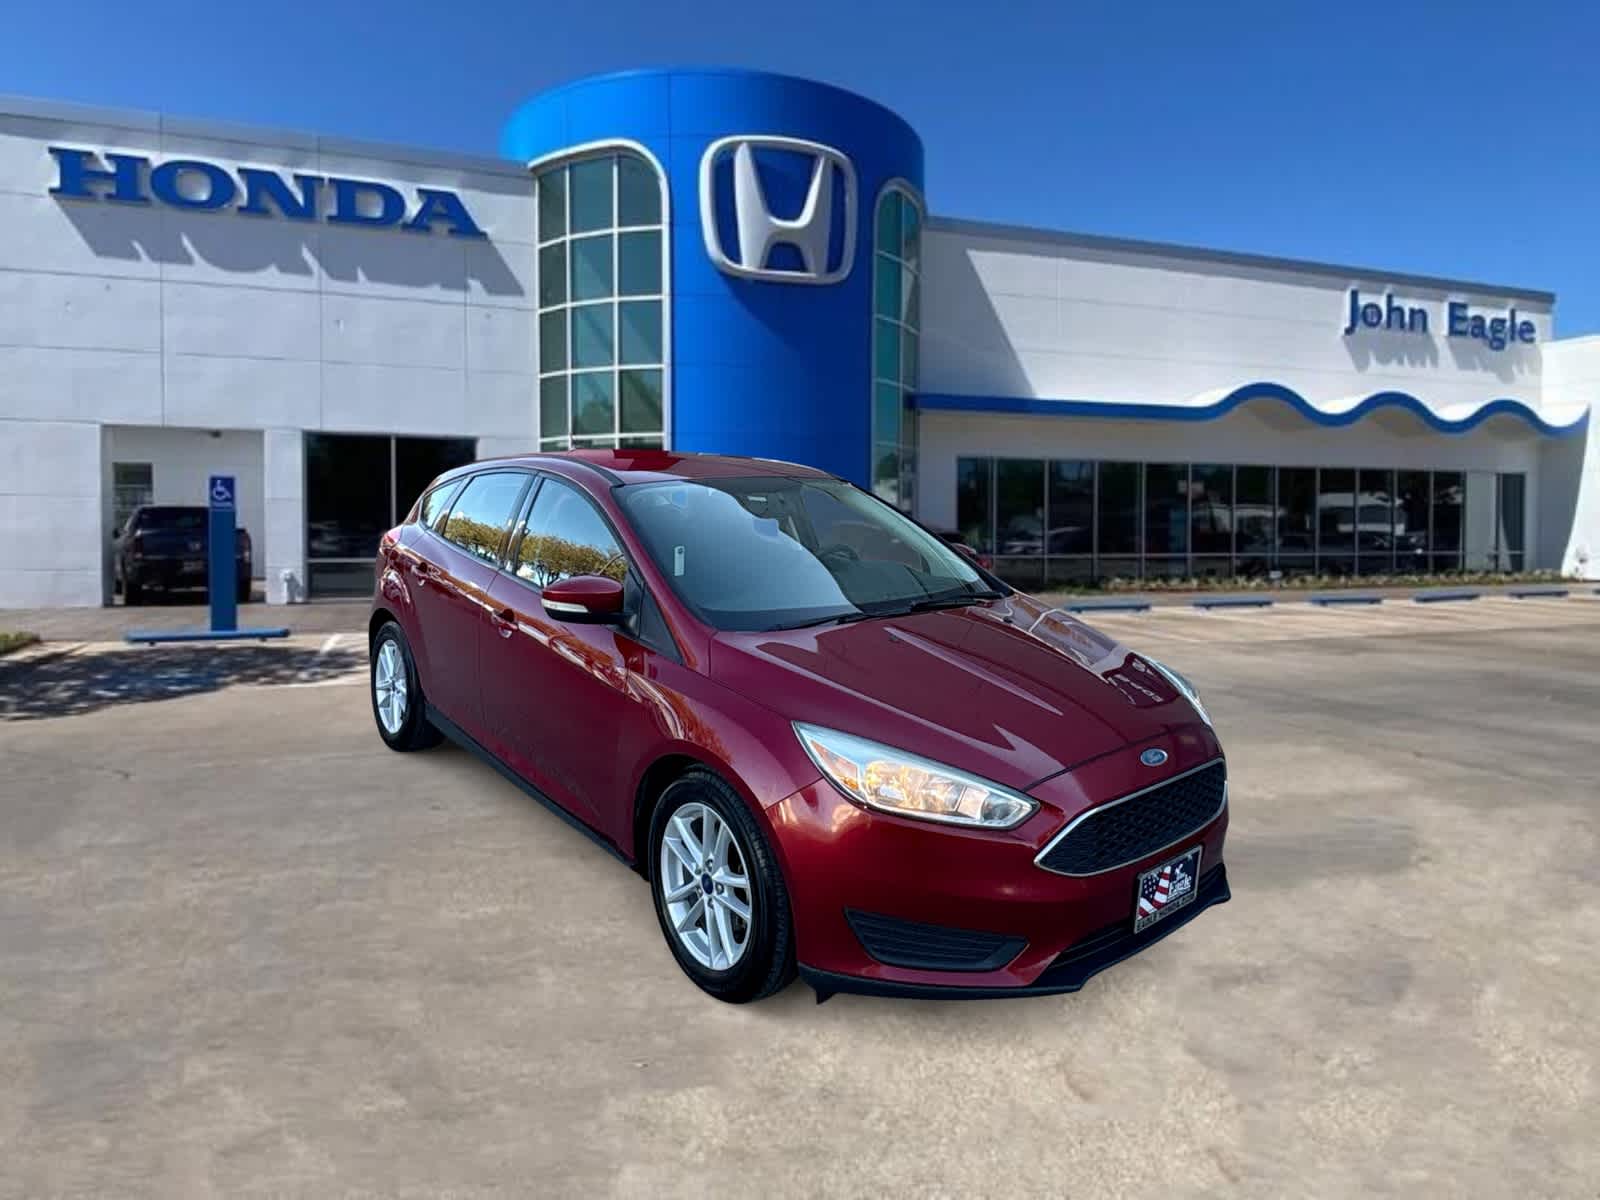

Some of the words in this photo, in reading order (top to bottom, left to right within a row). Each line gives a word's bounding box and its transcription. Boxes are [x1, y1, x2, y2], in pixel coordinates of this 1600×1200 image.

[48, 146, 488, 240] HONDA
[1344, 289, 1429, 336] John
[1448, 302, 1536, 351] Eagle
